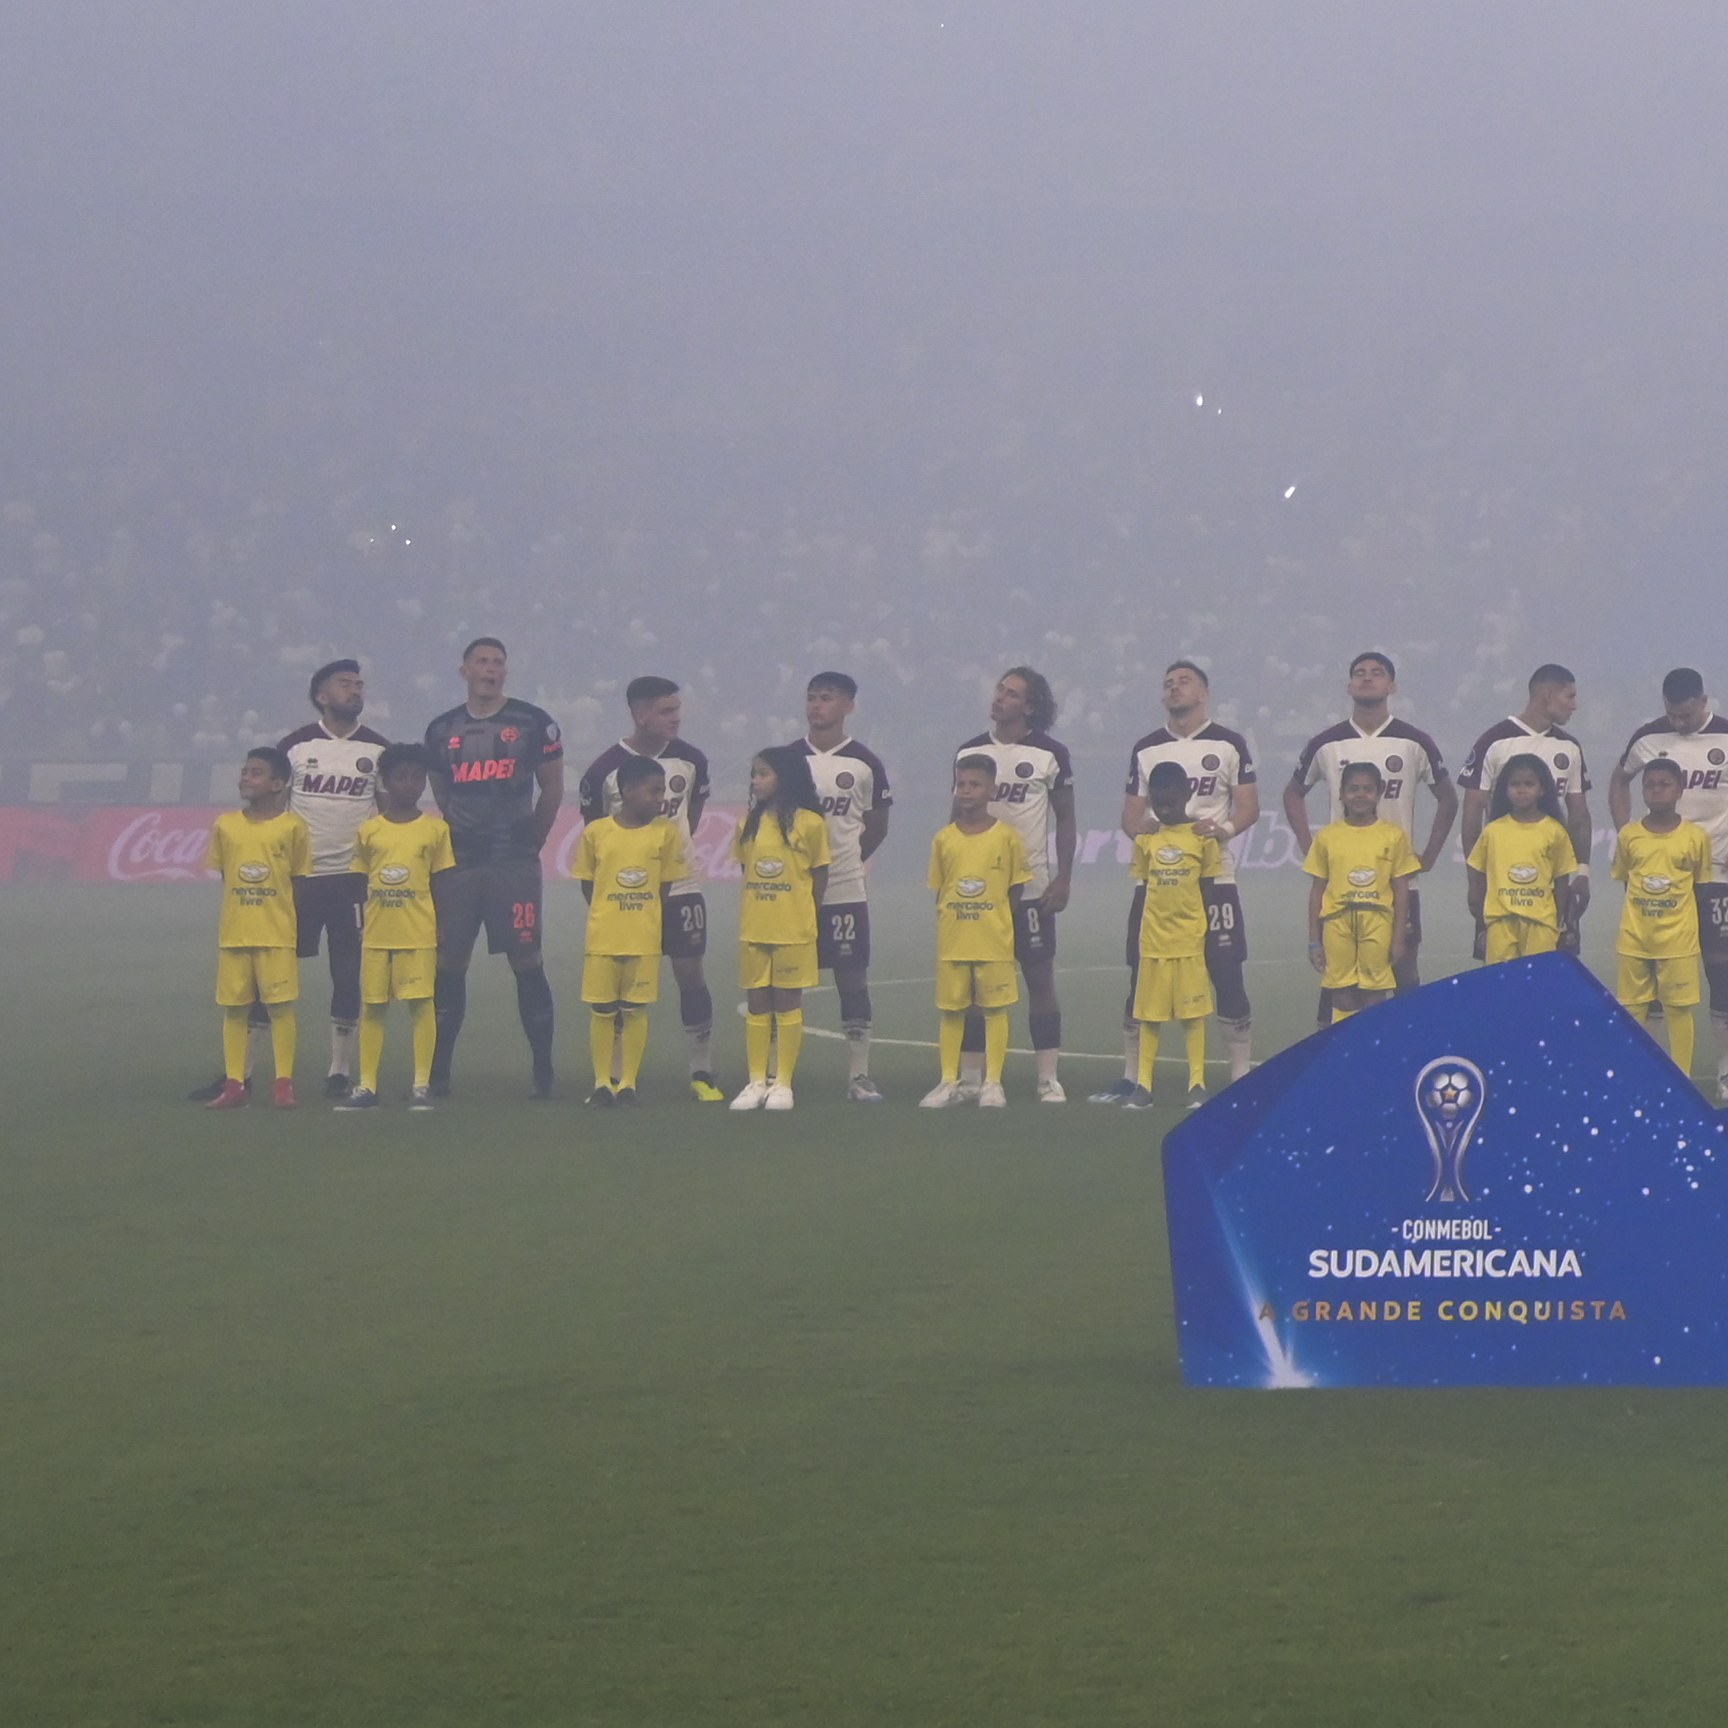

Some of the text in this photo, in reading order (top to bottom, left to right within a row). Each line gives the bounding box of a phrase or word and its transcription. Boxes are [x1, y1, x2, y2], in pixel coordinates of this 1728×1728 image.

[994, 782, 1030, 803] PEI
[1187, 776, 1217, 797] PEI
[823, 796, 852, 816] PEI
[232, 887, 277, 897] mercado
[240, 897, 263, 907] livre
[1500, 888, 1546, 898] mercado
[1511, 897, 1534, 907] livre
[620, 902, 644, 912] livre
[947, 902, 993, 912] mercado
[1633, 897, 1679, 908] mercado
[513, 902, 535, 928] 26
[681, 904, 704, 932] 20
[956, 911, 980, 921] livre
[1209, 902, 1234, 931] 29
[832, 914, 855, 940] 22
[1402, 1219, 1493, 1241] CONMEBOL
[1308, 1248, 1582, 1278] SUDAMERICANA
[1258, 1300, 1627, 1325] A GRANDE CONQUISTA
